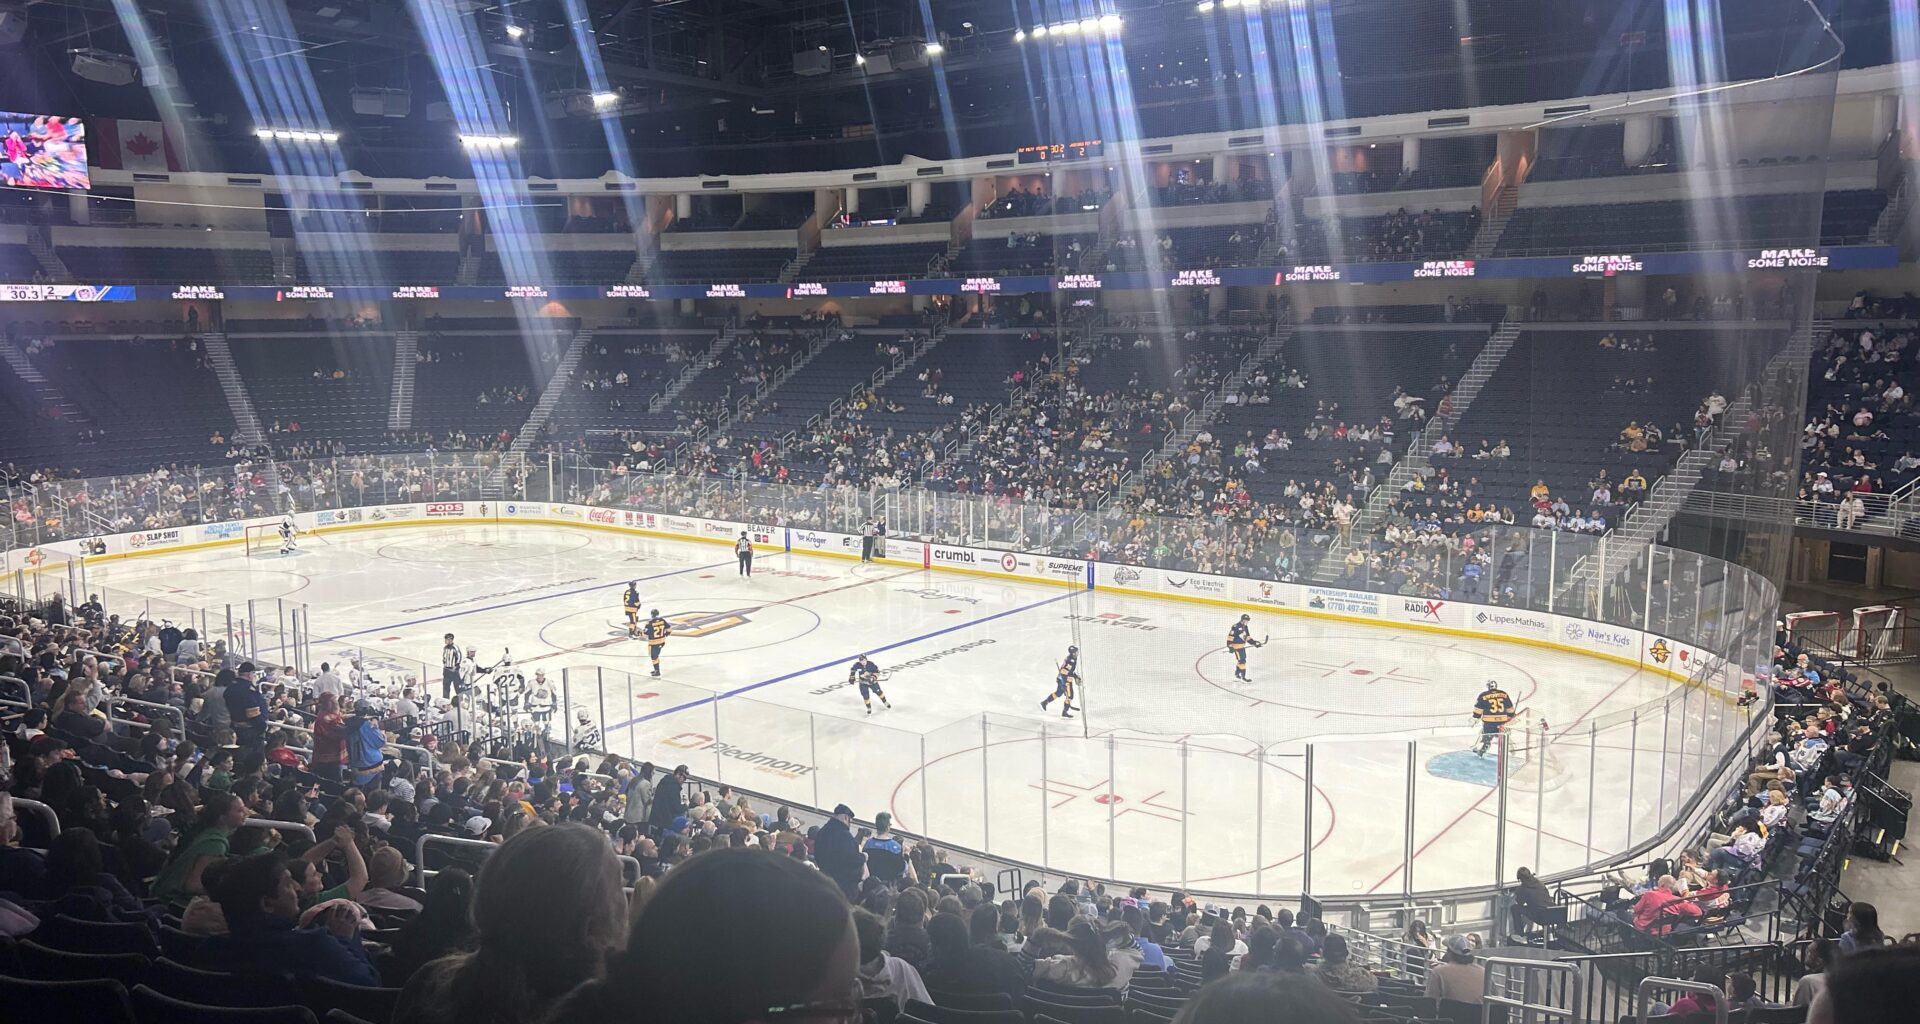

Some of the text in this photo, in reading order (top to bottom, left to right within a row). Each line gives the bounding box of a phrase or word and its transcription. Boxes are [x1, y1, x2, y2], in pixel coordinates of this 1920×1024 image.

[1079, 147, 1085, 156] 2
[1761, 249, 1816, 259] MAKE
[1583, 255, 1632, 264] MAKE
[1748, 256, 1829, 267] SOME NOISE
[1293, 265, 1331, 274] MAKE
[1424, 261, 1465, 269] MAKE
[1573, 263, 1642, 272] SOME NOISE
[1179, 270, 1213, 278] MAKE
[1285, 271, 1340, 280] SOME NOISE
[1414, 268, 1475, 277] SOME NOISE
[1195, 277, 1220, 285] NOISE
[47, 286, 55, 295] 2
[180, 285, 215, 293] MAKE
[11, 290, 39, 300] 30.3
[426, 504, 462, 512] PODS
[748, 524, 775, 534] BEAVER
[146, 531, 178, 541] SLAP SHOT
[805, 532, 827, 548] Kroger
[934, 548, 975, 563] crumbl
[1048, 562, 1083, 572] SUPREME
[1309, 588, 1377, 601] PARTNERSHIPS AVAILABLE
[1328, 602, 1378, 615] (770) 497-5100
[654, 626, 665, 638] 27
[1587, 628, 1630, 646] Nan's Kids
[500, 673, 515, 688] 22
[1489, 699, 1505, 712] 35
[700, 742, 818, 775] Piedmont
